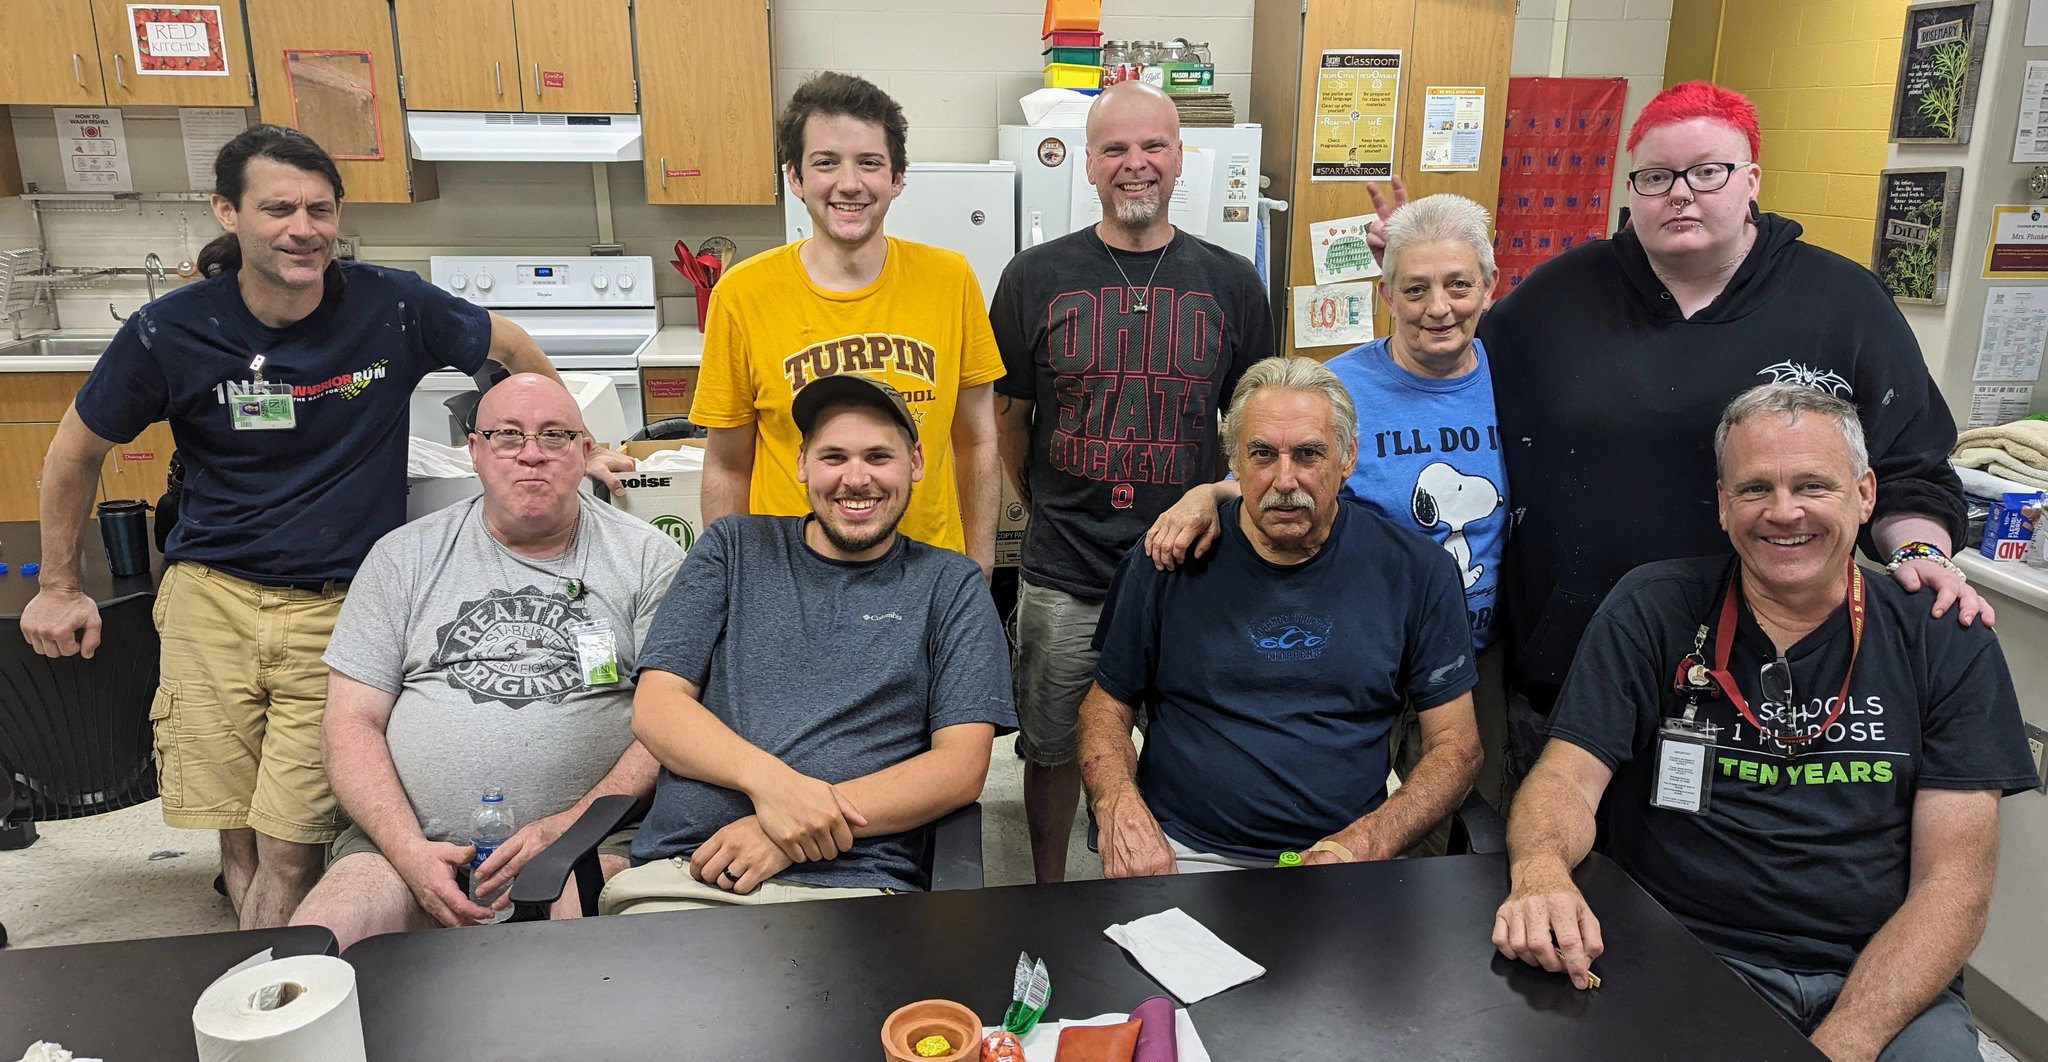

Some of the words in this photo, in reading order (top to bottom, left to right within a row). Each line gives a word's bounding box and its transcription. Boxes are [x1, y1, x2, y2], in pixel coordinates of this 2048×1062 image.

[155, 24, 198, 40] RED
[1921, 25, 1959, 42] ROSEMARY
[151, 41, 206, 52] KITCHEN
[1343, 55, 1399, 66] Classroom
[1145, 72, 1162, 83] Ball
[1522, 155, 1531, 166] 11
[1316, 167, 1388, 175] #SPARTANSTRONG
[1590, 196, 1601, 208] 21
[1512, 237, 1523, 248] 25
[1310, 295, 1359, 329] LOVE
[1048, 286, 1225, 379] OHIO
[783, 333, 937, 396] TURPIN
[308, 393, 324, 402] RACE
[1054, 375, 1212, 442] STATE
[1374, 428, 1432, 458] I'LL
[1438, 426, 1480, 453] DO
[1111, 483, 1134, 509] O
[2008, 512, 2019, 538] FLEXIBLE
[2013, 518, 2022, 538] FABRIC
[997, 532, 1013, 540] COPY
[453, 600, 580, 647] REALTRE
[870, 612, 903, 621] Columbia
[1266, 649, 1321, 661] CHOPPERS
[453, 660, 581, 696] ORIGINA
[1759, 695, 1884, 723] SCHOOLS
[1732, 723, 1742, 741] 1
[1718, 757, 1779, 786] TEN
[1786, 761, 1895, 786] YEARS
